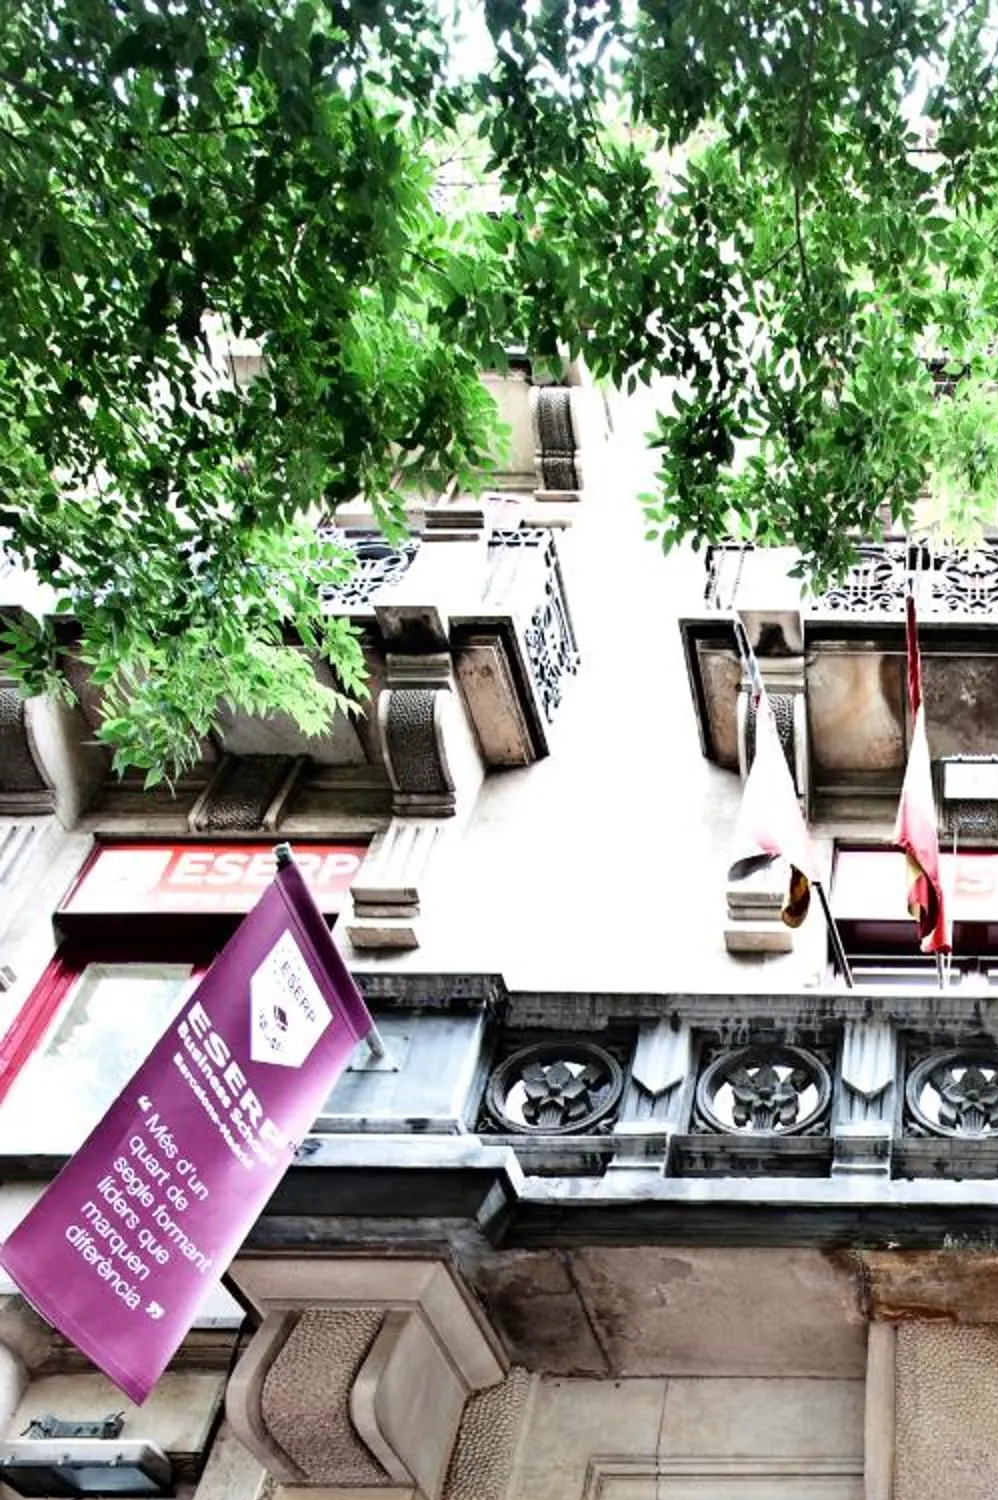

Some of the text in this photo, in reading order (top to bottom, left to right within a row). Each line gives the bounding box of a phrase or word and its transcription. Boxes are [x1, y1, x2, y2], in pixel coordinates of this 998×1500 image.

[177, 1020, 232, 1109] Business
[187, 1000, 285, 1150] ESERP
[113, 1156, 213, 1273] segle formant
[129, 1135, 189, 1211] quart de
[80, 1200, 151, 1281] marquen
[97, 1174, 170, 1265] líders que
